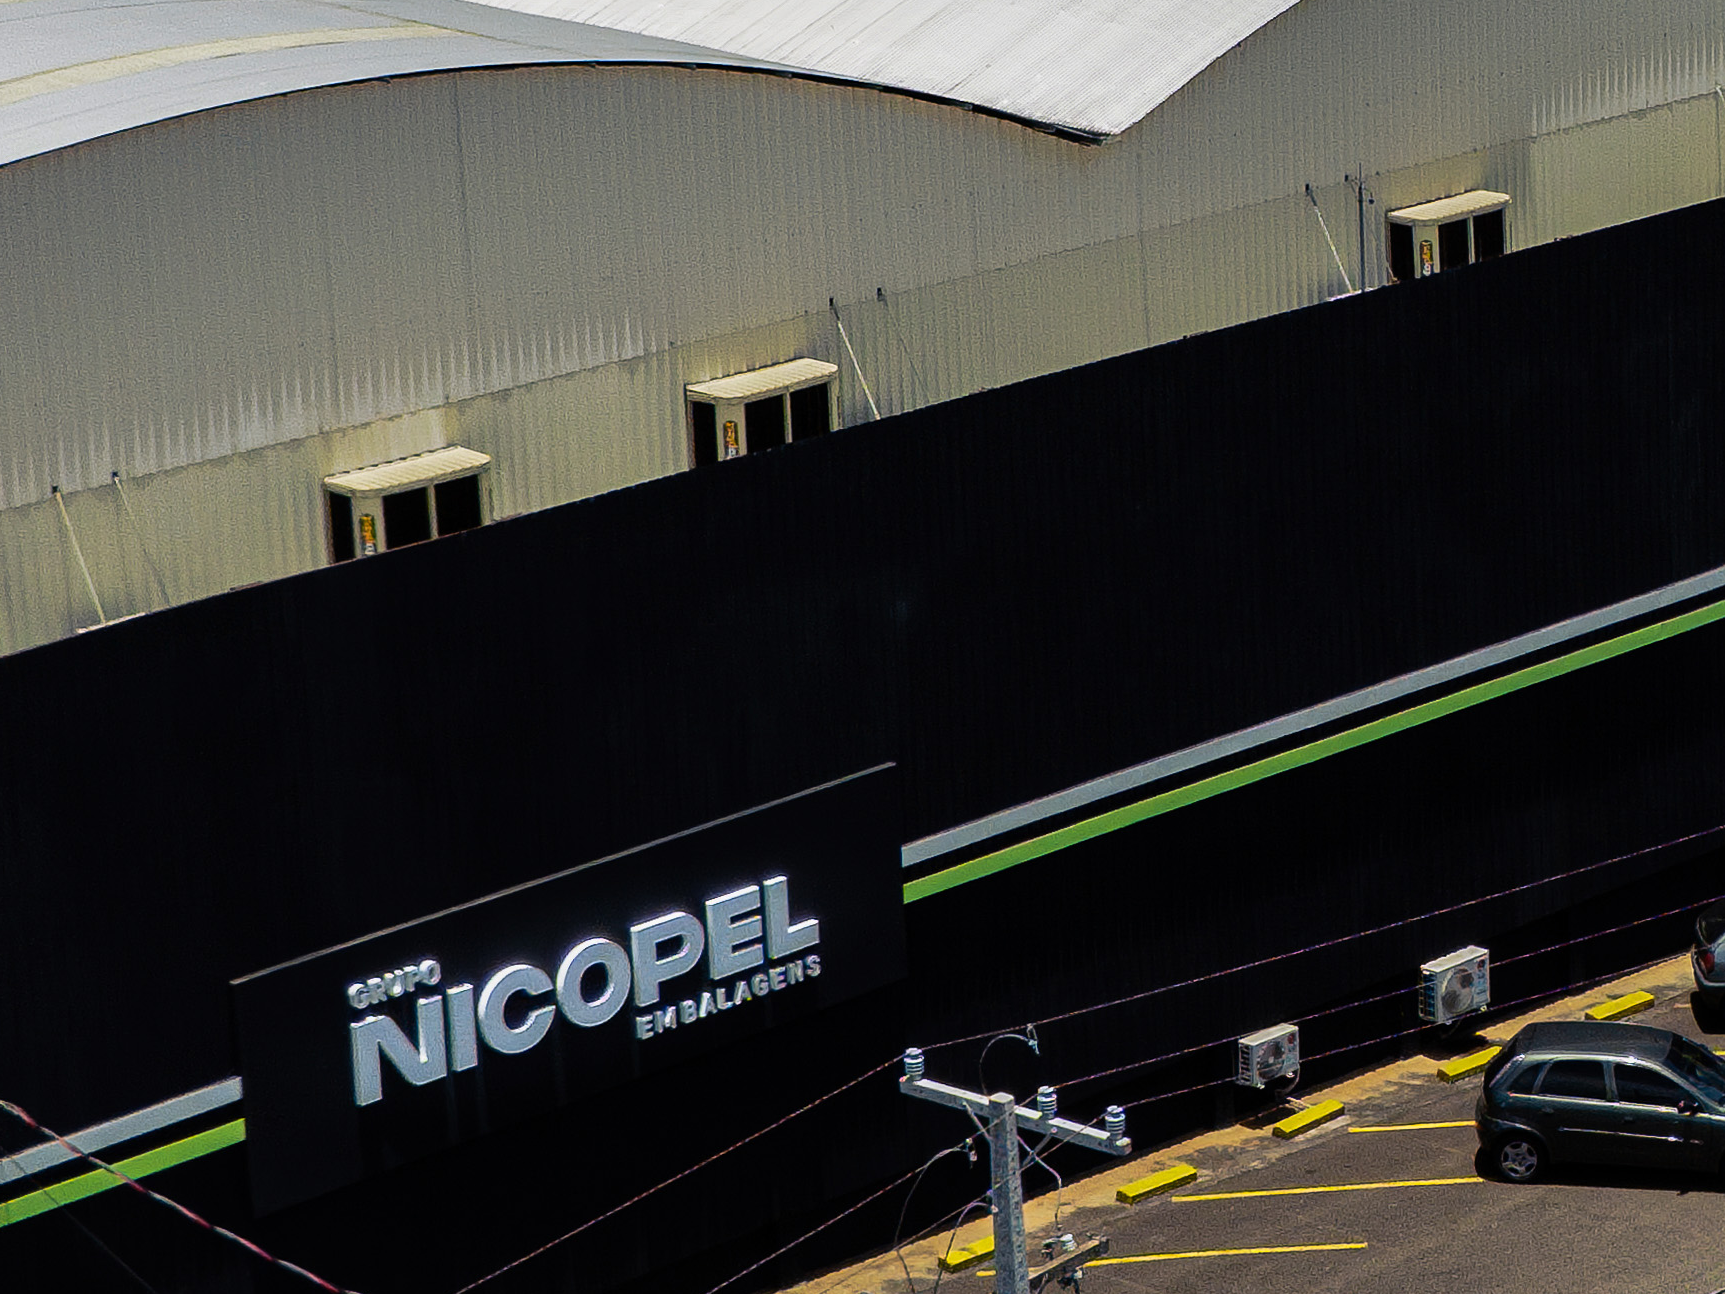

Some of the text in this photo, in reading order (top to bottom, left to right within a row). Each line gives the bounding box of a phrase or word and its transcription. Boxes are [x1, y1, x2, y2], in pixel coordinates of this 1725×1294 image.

[347, 959, 442, 1009] GRUPO
[349, 875, 820, 1106] NICOPEL
[635, 954, 822, 1040] EMBALAGENS
